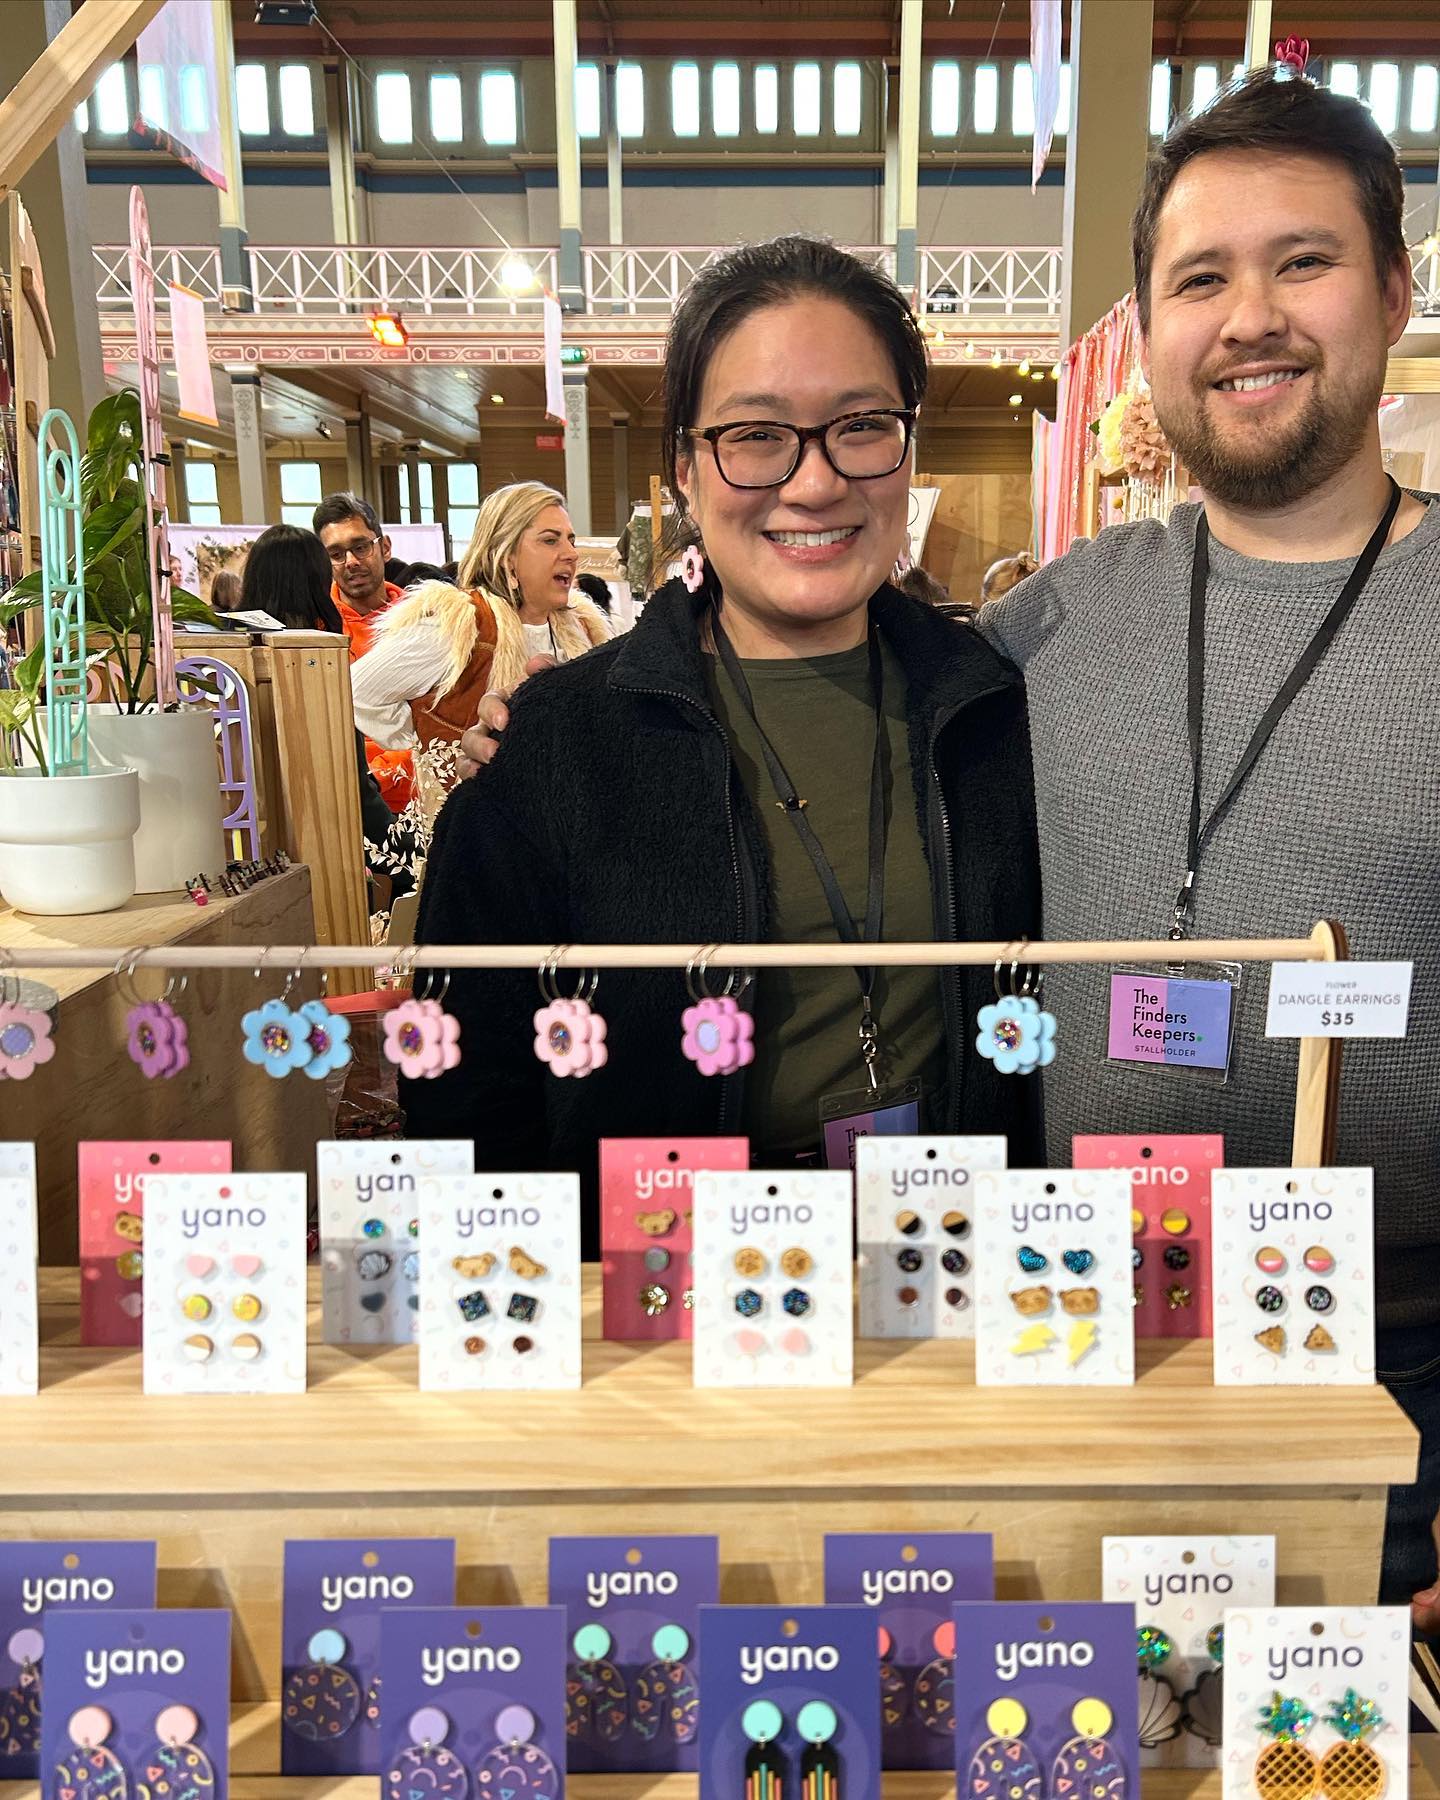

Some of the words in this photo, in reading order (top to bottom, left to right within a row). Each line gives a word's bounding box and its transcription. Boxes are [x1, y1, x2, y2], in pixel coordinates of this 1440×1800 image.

[1133, 988, 1159, 1005] The
[1278, 994, 1331, 1005] DANGLE
[1335, 994, 1401, 1005] EARRINGS
[1133, 1005, 1187, 1024] Finders
[1321, 1011, 1354, 1026] $35
[1134, 1045, 1196, 1057] STALLHOLDER
[356, 1174, 416, 1203] yan
[634, 1168, 694, 1199] yan
[890, 1168, 970, 1198] yano
[1130, 1165, 1190, 1185] ano
[181, 1207, 267, 1240] yano
[456, 1207, 541, 1239] yano
[730, 1204, 813, 1236] yano
[1011, 1202, 1095, 1234] yano
[1249, 1201, 1333, 1233] yano
[23, 1577, 114, 1613] yano
[322, 1575, 414, 1612] yano
[587, 1571, 678, 1608] yano
[862, 1569, 954, 1606] yano
[1145, 1573, 1234, 1607] yano
[85, 1649, 185, 1689] yano
[422, 1646, 521, 1686] yano
[740, 1645, 839, 1685] yano
[995, 1641, 1094, 1681] yano
[1268, 1646, 1364, 1681] yano
